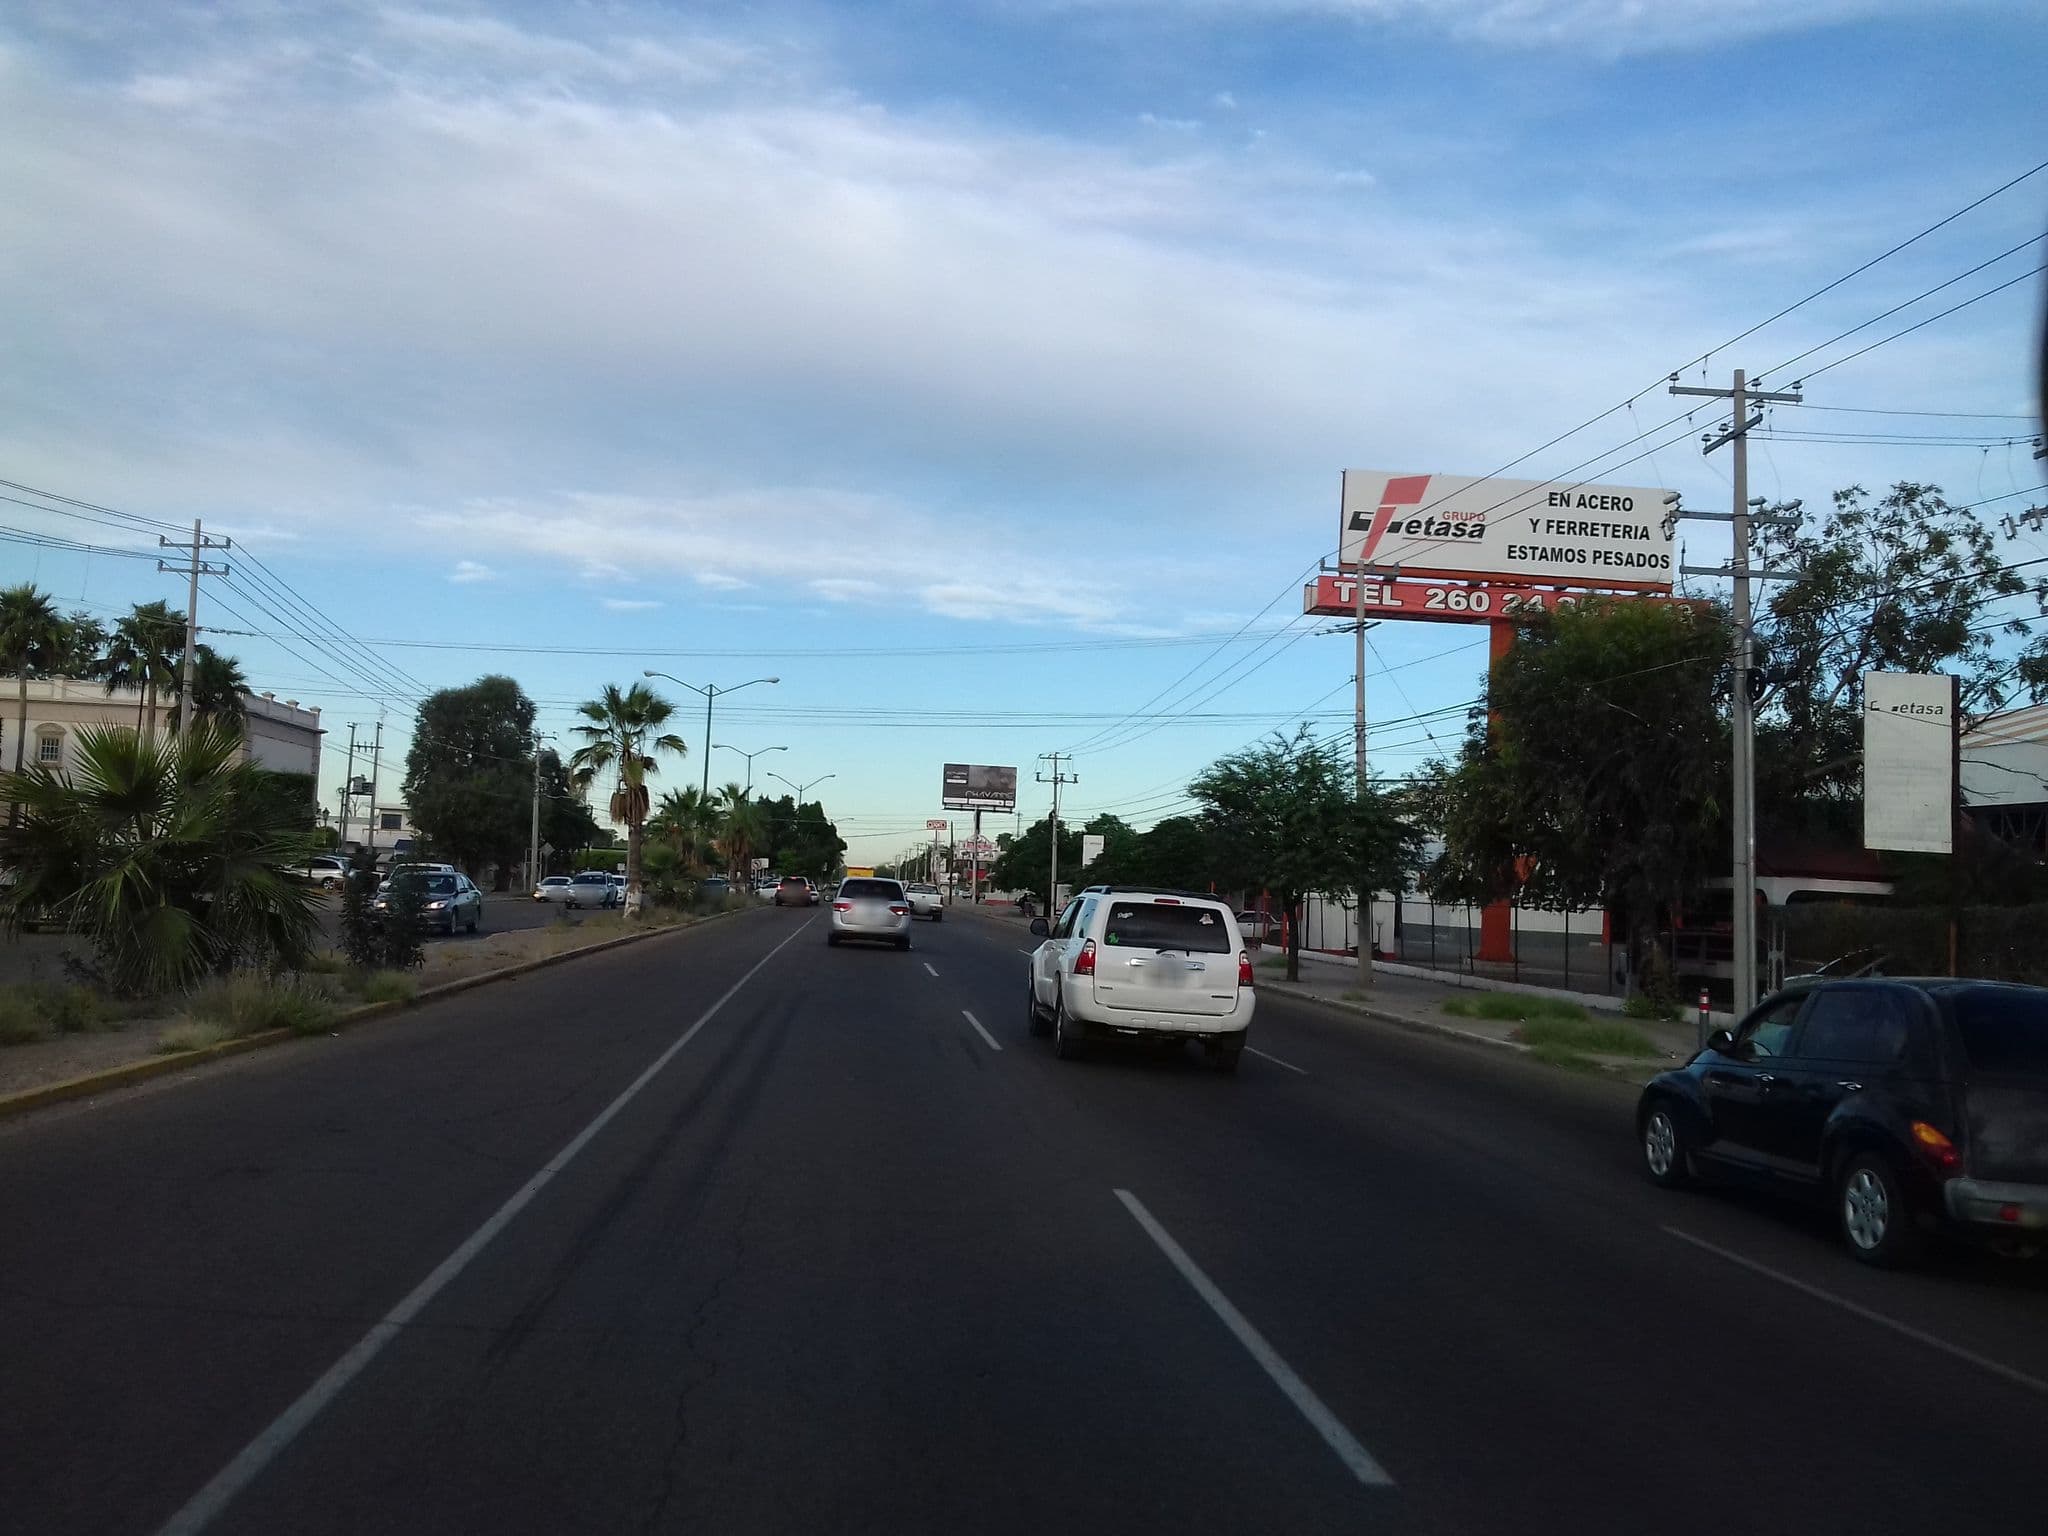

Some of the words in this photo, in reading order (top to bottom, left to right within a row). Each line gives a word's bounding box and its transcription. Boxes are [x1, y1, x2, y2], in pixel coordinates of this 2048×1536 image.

[1548, 491, 1570, 509] EN
[1576, 493, 1634, 512] ACERO
[1442, 511, 1486, 522] GRUPO
[1529, 518, 1542, 533] Y
[1545, 519, 1651, 541] FERRETERIA
[1507, 545, 1587, 564] ESTAMOS
[1592, 549, 1670, 569] PESADOS
[1333, 581, 1402, 606] TEL
[1424, 587, 1490, 612] 260
